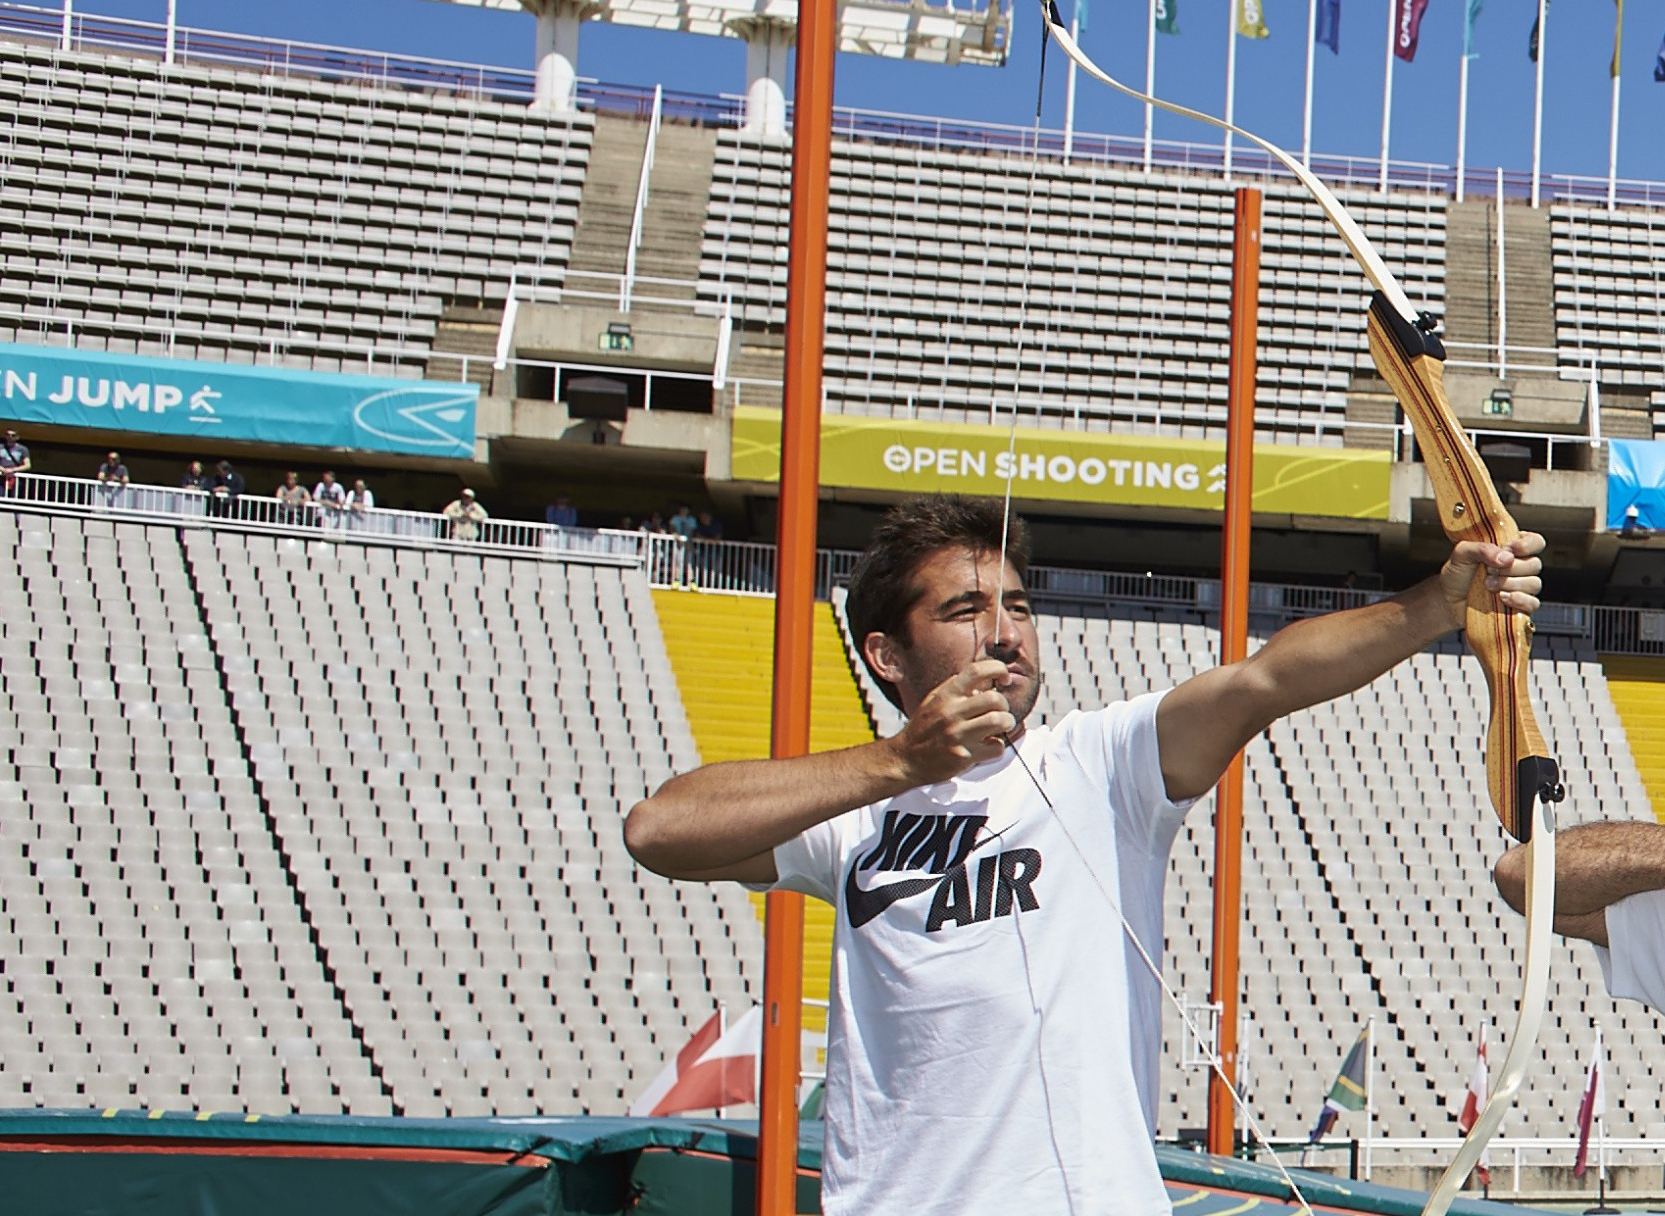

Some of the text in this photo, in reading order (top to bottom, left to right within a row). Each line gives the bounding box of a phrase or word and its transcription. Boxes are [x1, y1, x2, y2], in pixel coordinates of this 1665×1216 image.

[48, 375, 183, 414] JUMP
[883, 444, 1201, 492] OPEN SHOOTING
[925, 848, 1042, 933] AIR
